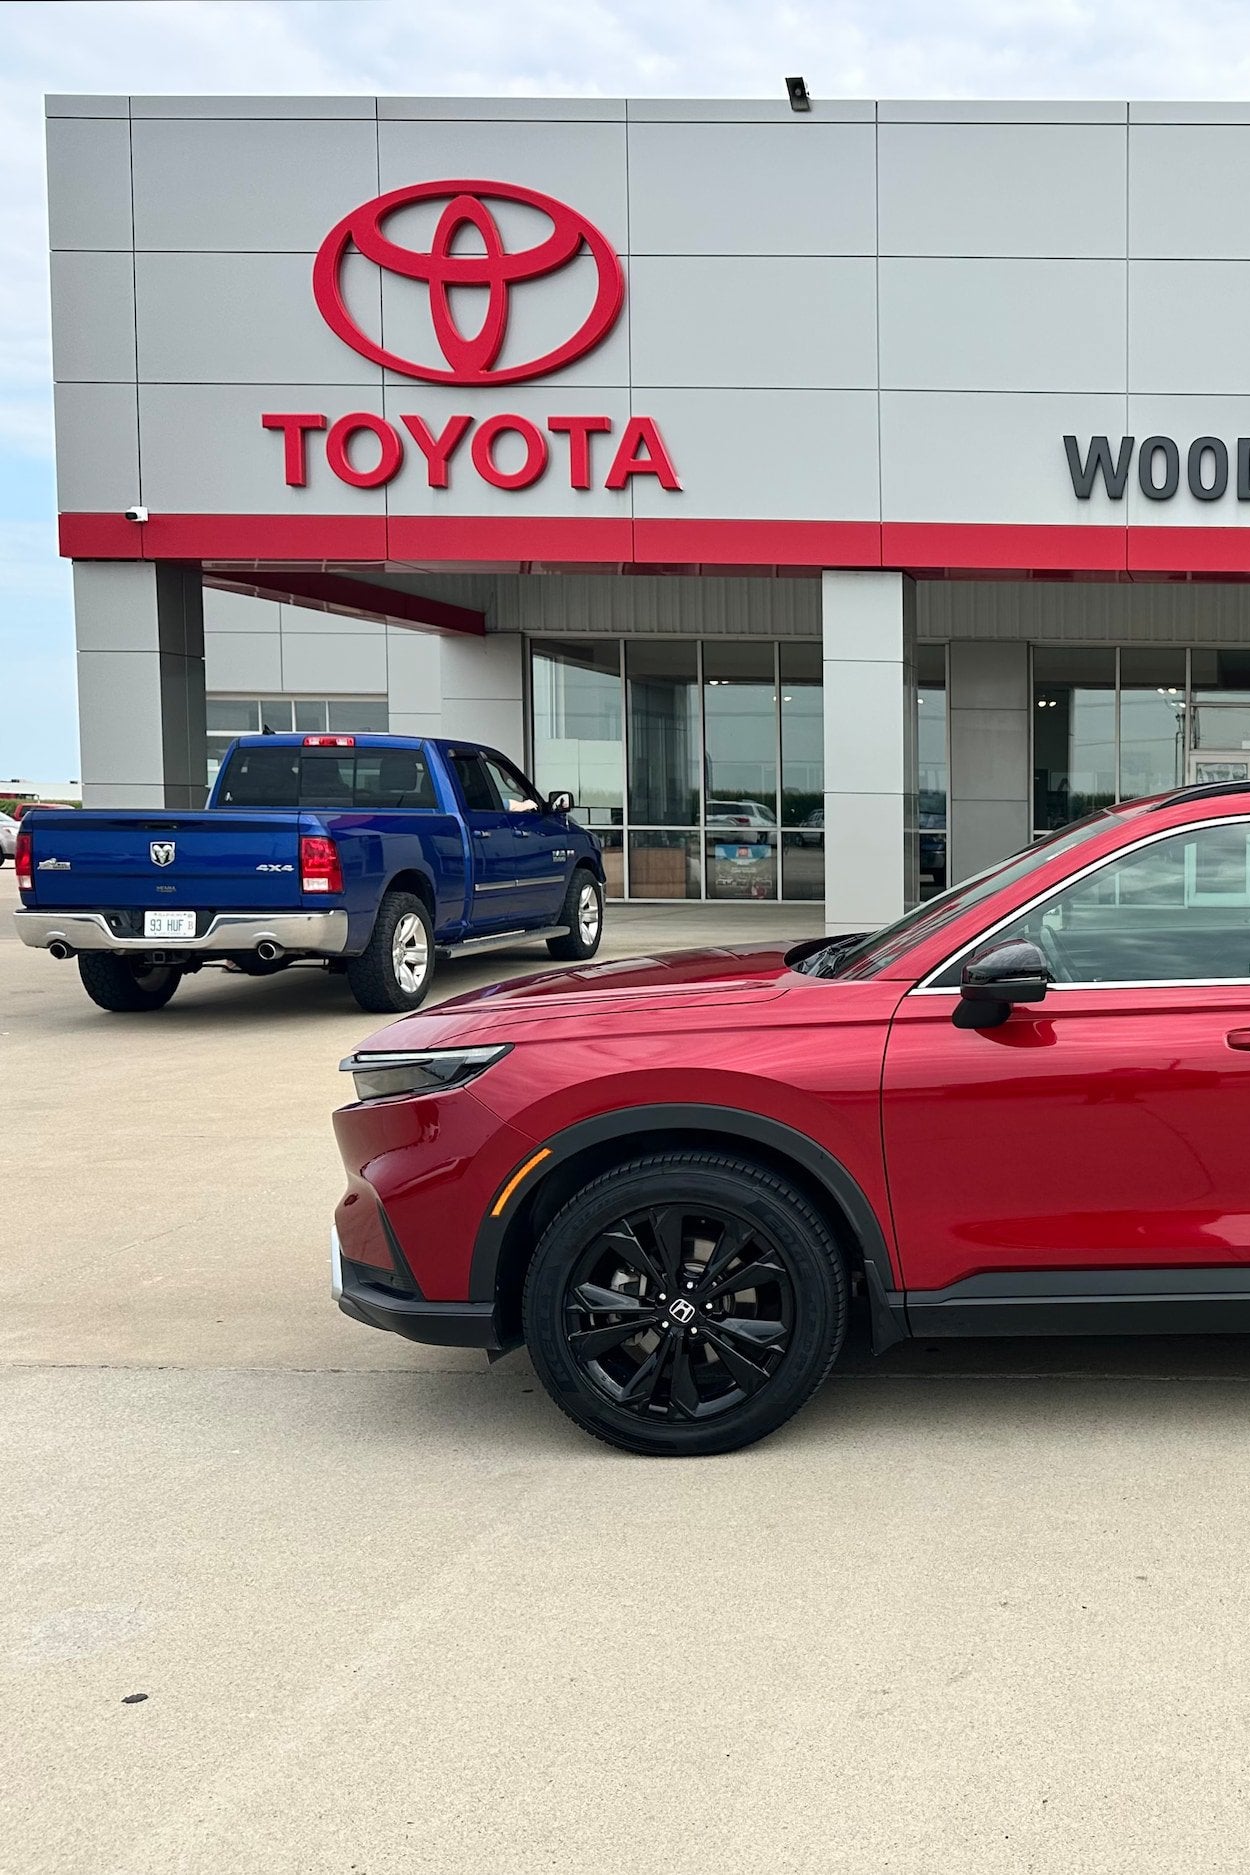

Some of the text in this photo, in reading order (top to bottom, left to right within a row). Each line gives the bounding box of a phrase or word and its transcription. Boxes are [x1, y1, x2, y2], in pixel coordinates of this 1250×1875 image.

[261, 412, 684, 490] TOYOTA
[151, 919, 161, 931] 93
[167, 919, 184, 931] HUF
